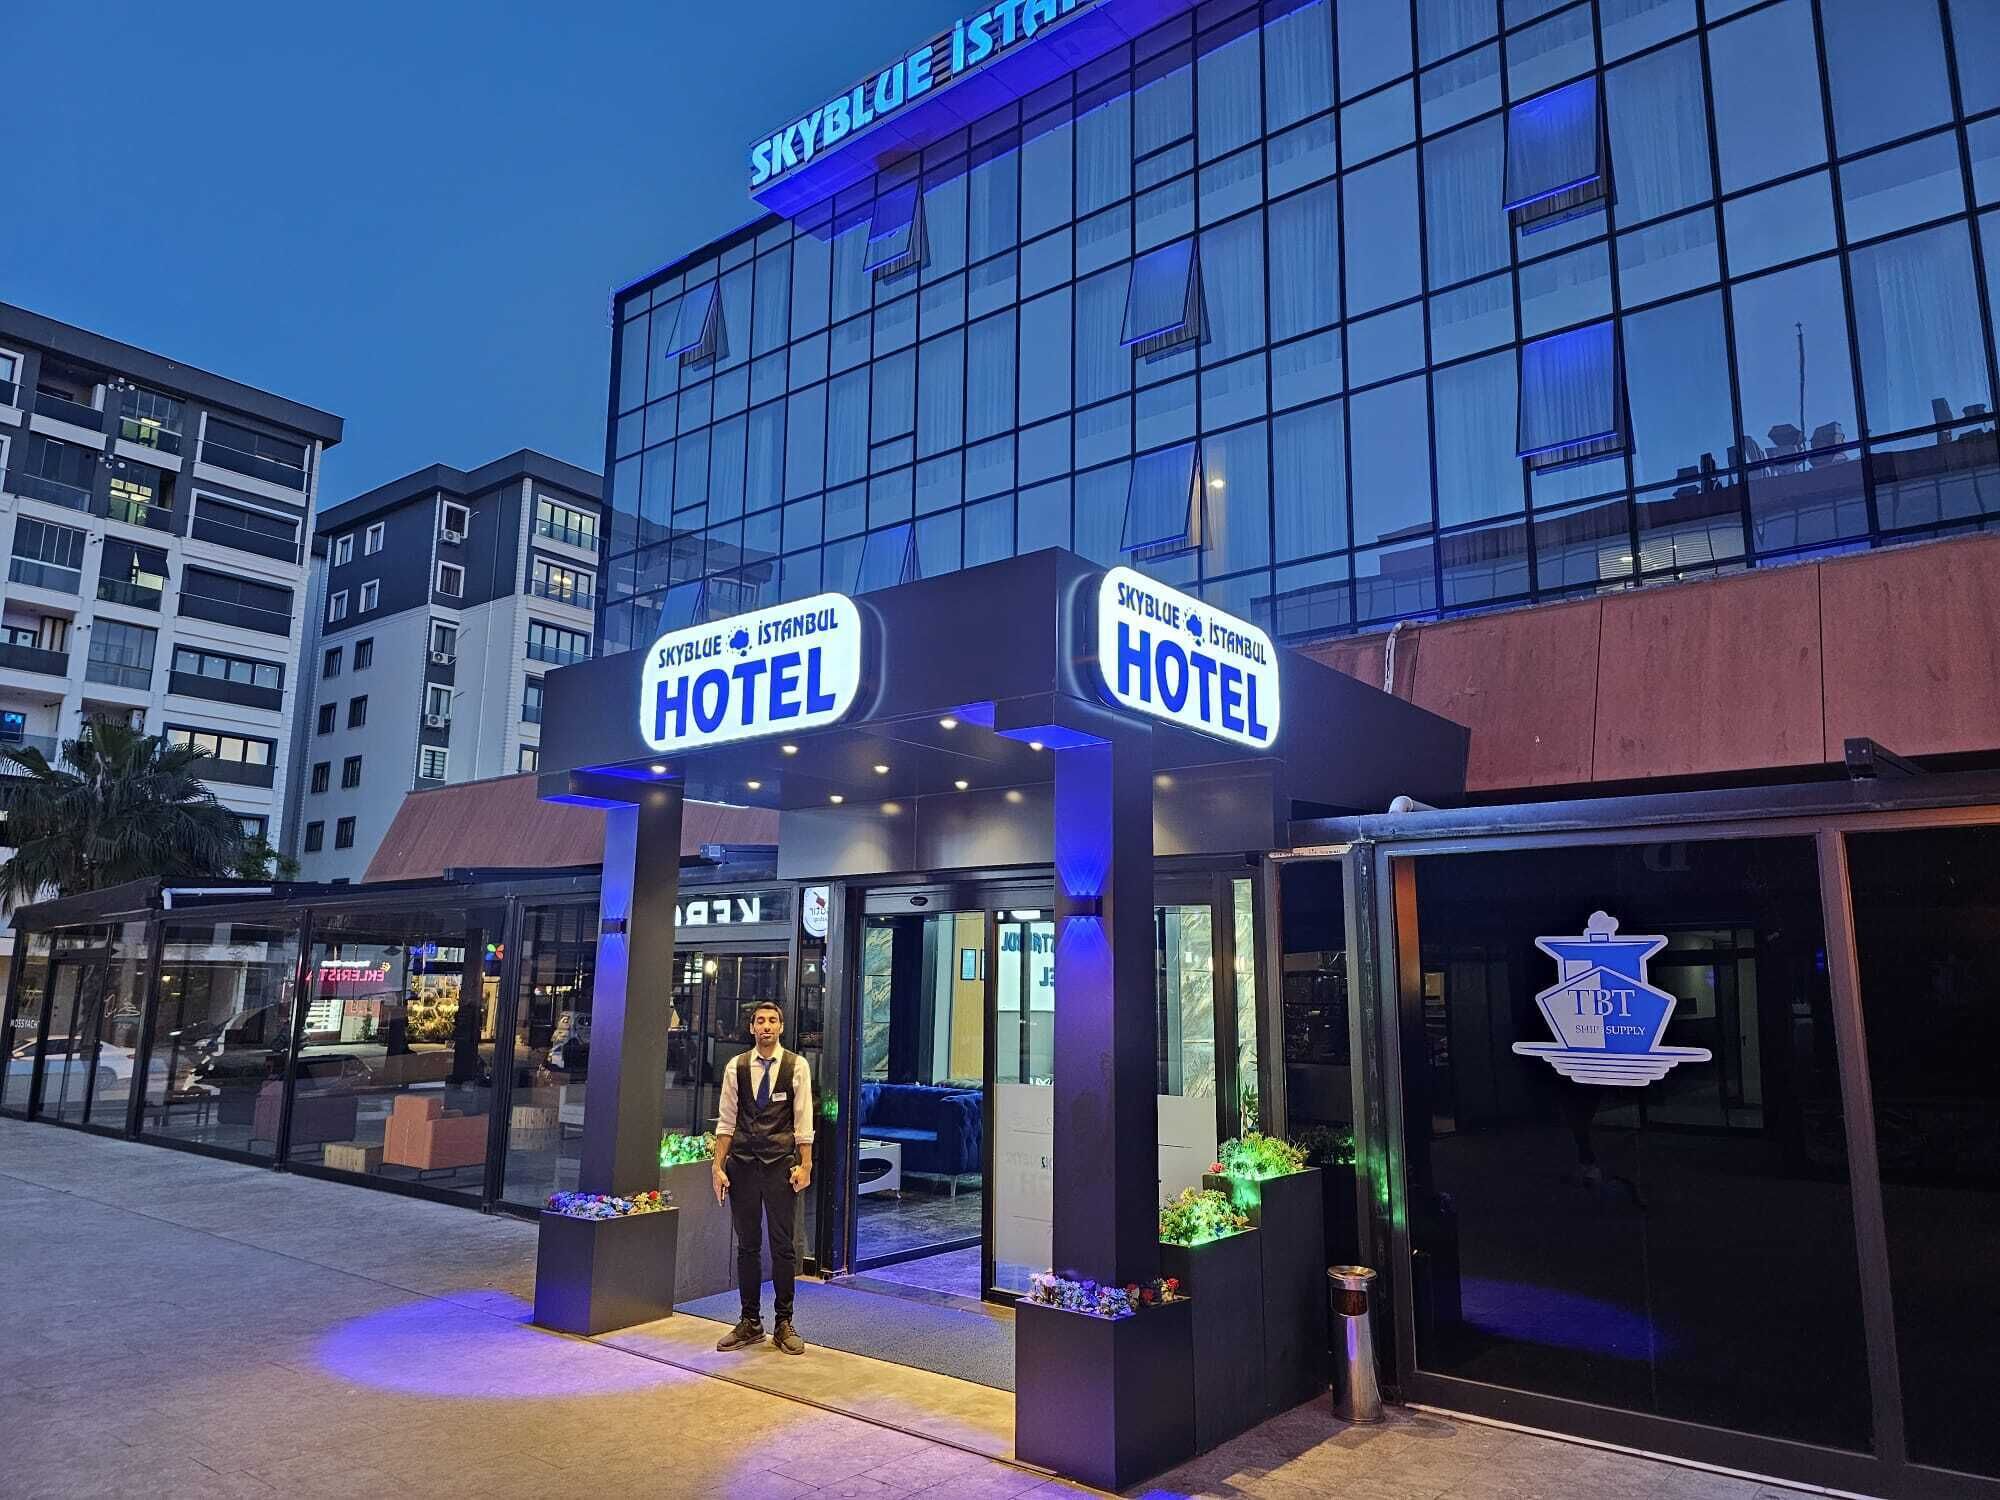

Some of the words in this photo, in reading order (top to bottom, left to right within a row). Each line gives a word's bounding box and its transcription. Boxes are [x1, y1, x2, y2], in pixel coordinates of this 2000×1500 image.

[752, 46, 933, 185] SKYBLUE
[952, 0, 1076, 73] İSTA
[658, 635, 722, 668] SKYBLUE
[758, 607, 839, 646] İSTANBUL
[1117, 582, 1180, 630] SKYBLUE
[1209, 617, 1267, 665] İSTANBUL
[654, 646, 837, 741] HOTEL
[1117, 620, 1269, 741] HOTEL
[1567, 989, 1636, 1017] TBT
[1605, 1025, 1646, 1036] SUPPLY
